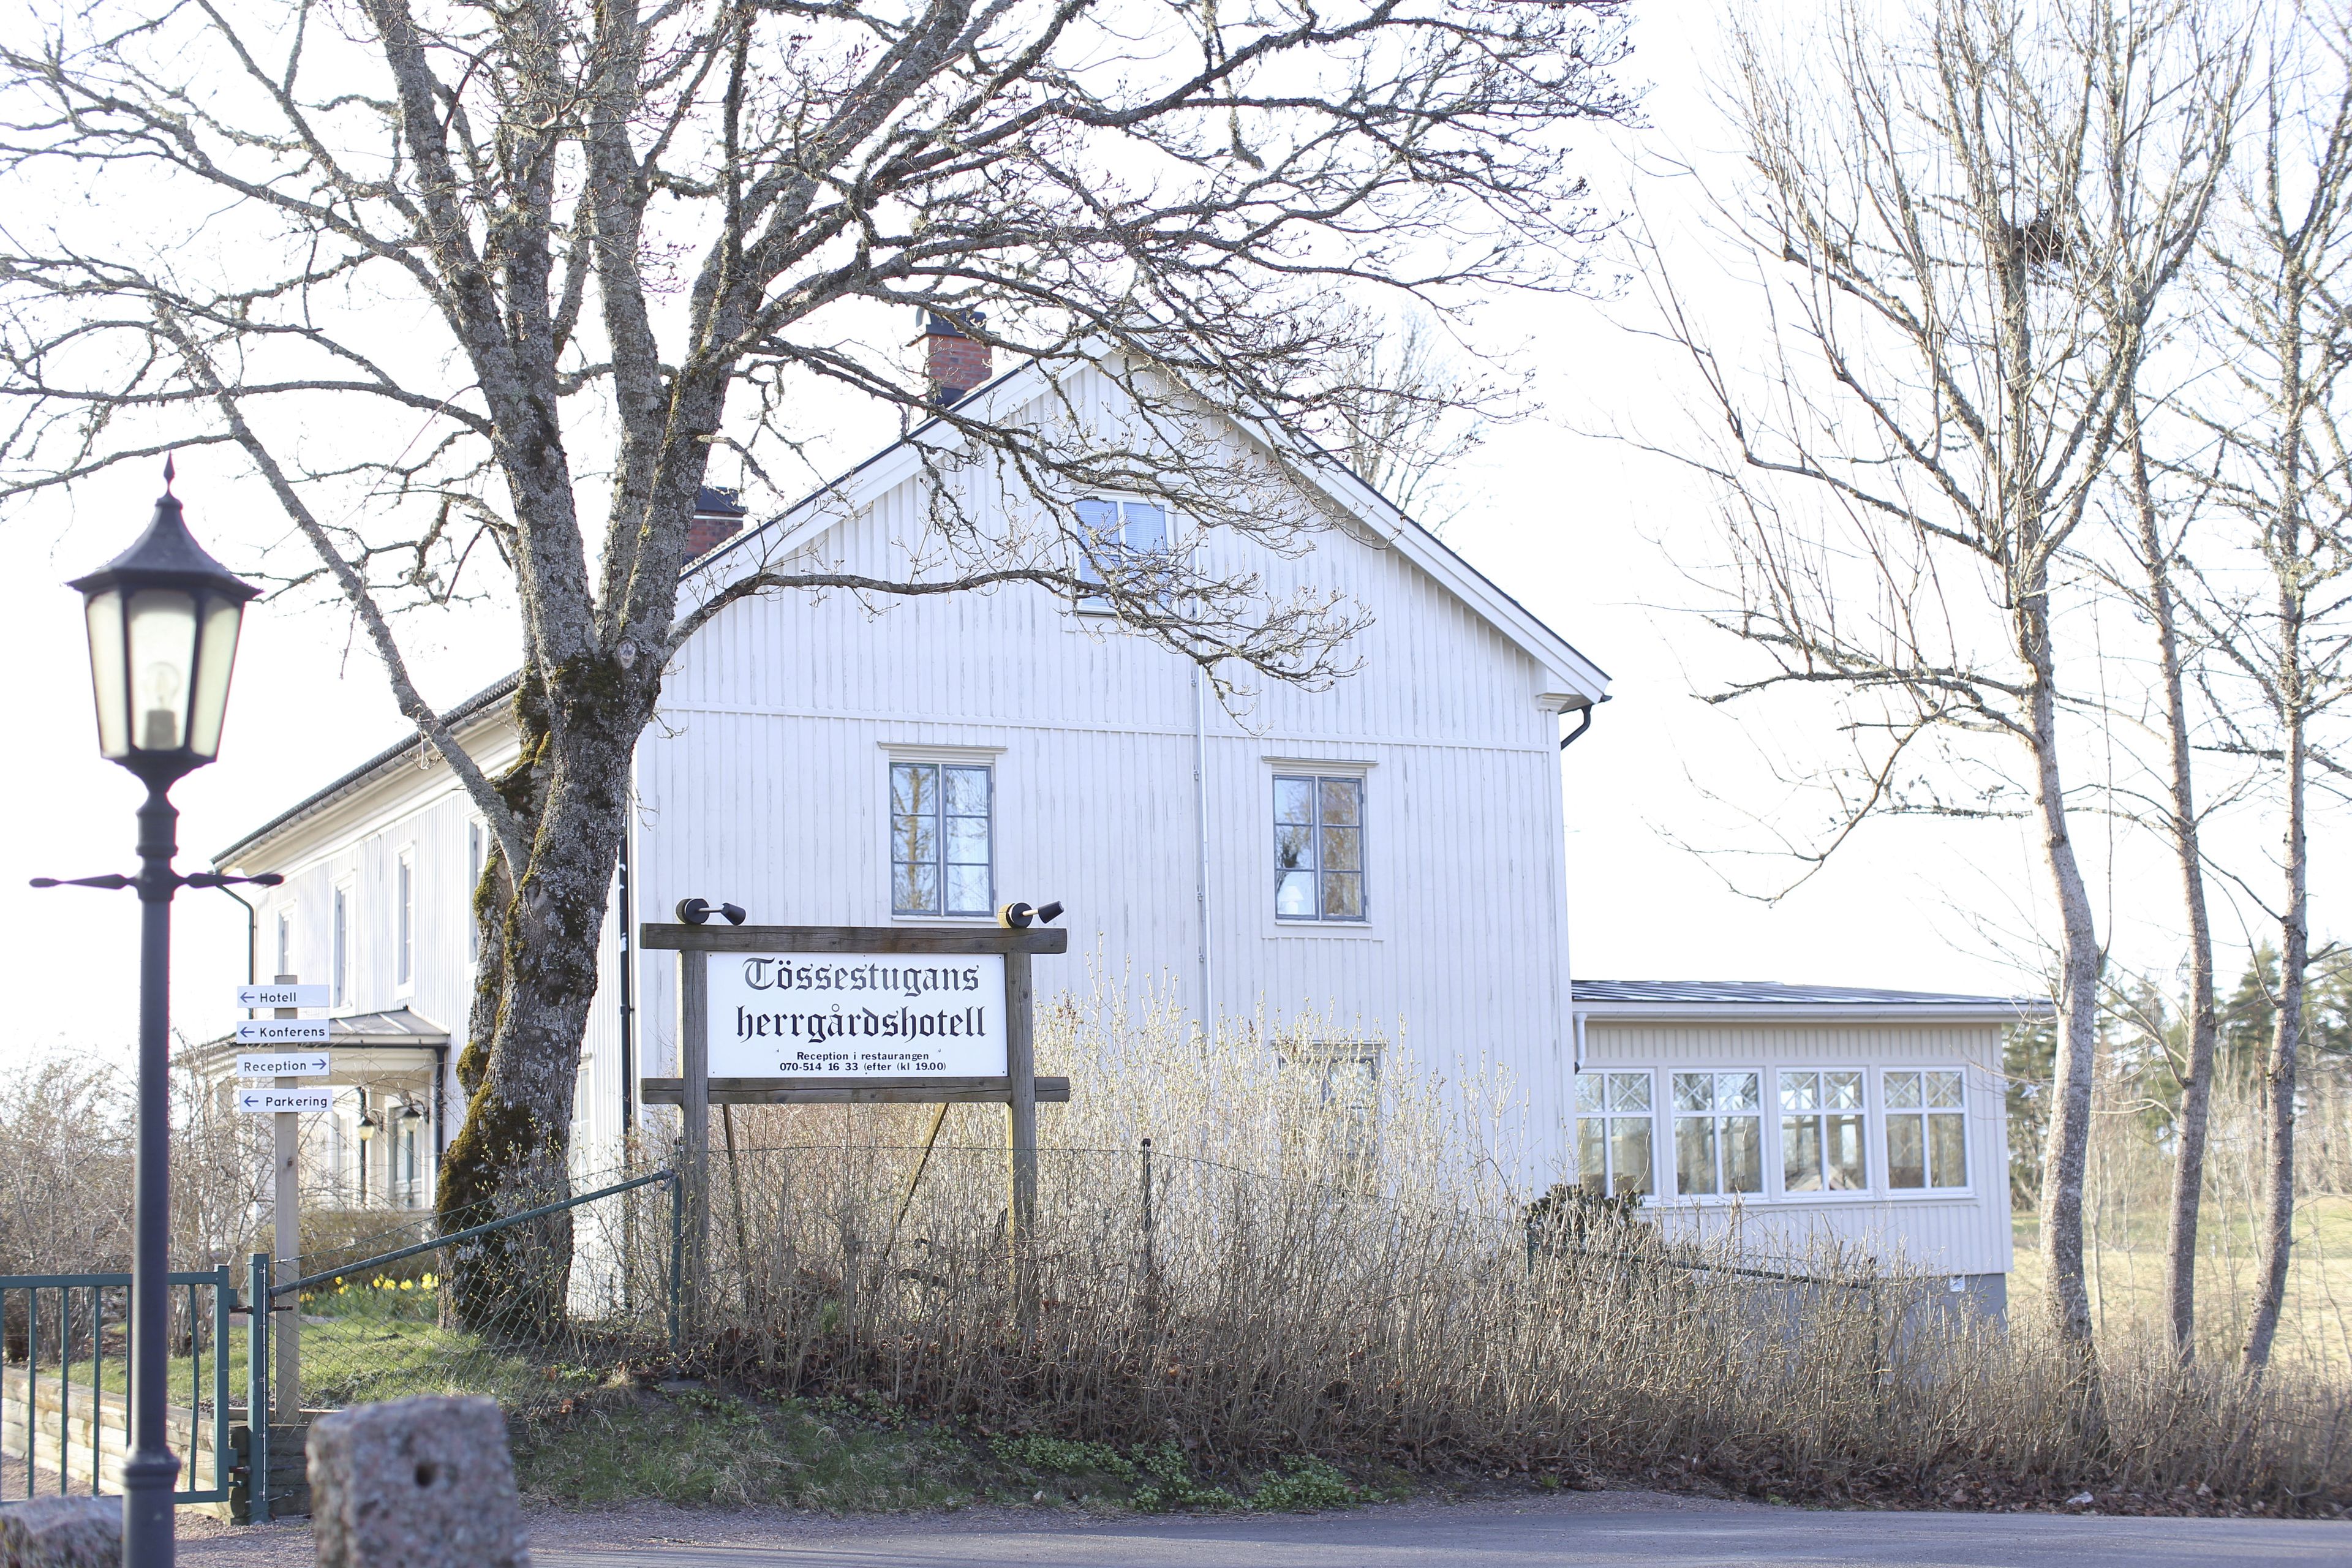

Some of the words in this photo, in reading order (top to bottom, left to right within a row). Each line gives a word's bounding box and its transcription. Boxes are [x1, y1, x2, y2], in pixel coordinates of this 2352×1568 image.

[742, 957, 980, 997] Tössestugans
[260, 992, 296, 1003] Hotell
[736, 1003, 987, 1043] herrgårdshotell
[260, 1027, 326, 1038] Konferens
[797, 1052, 849, 1062] Reception
[853, 1052, 857, 1060] i
[861, 1052, 929, 1062] restaurangen
[244, 1060, 307, 1074] Reception
[779, 1062, 823, 1071] 070-514
[828, 1062, 840, 1071] 16
[845, 1062, 859, 1071] 33
[864, 1062, 892, 1072] (efter
[897, 1062, 910, 1072] (kl
[916, 1062, 947, 1072] 19.00)
[266, 1096, 328, 1109] Parkering
